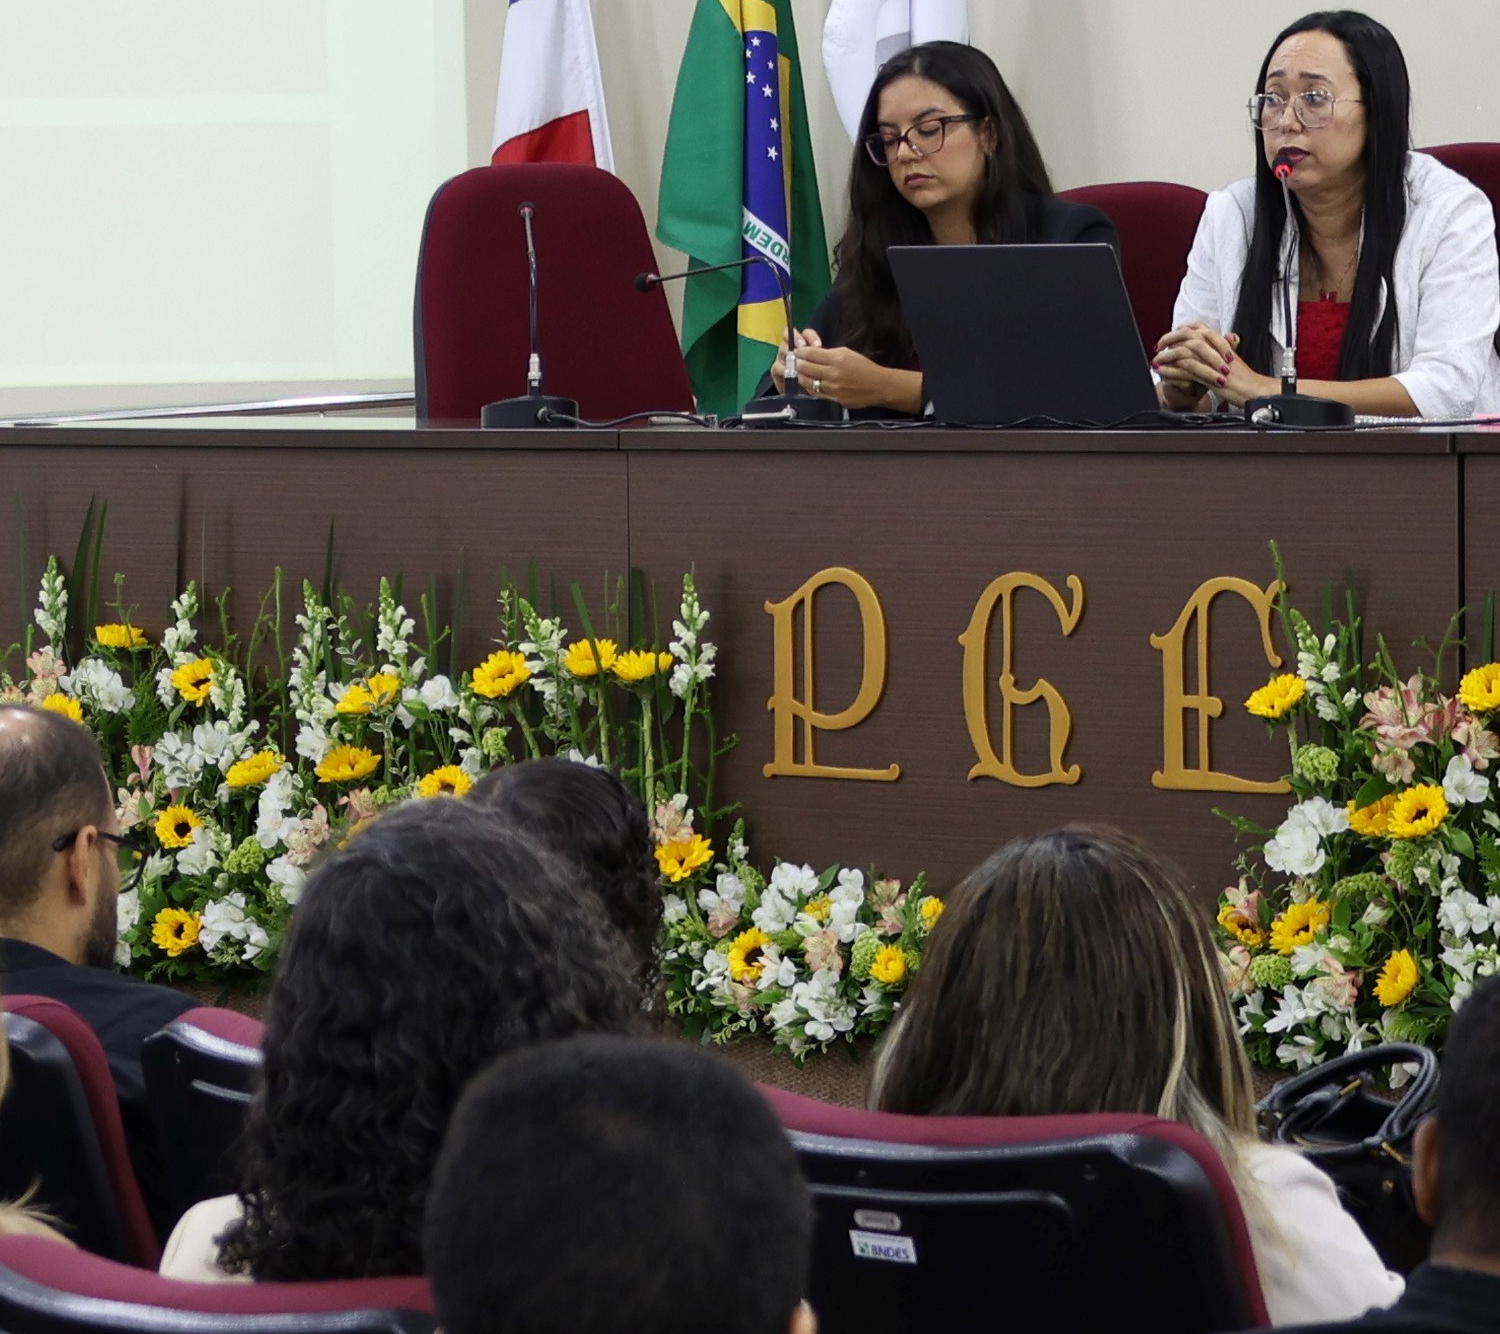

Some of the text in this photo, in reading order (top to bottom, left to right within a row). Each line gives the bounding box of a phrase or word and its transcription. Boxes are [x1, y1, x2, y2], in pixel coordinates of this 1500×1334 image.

[744, 221, 789, 265] RDEM
[762, 567, 1292, 794] PGE
[871, 1245, 909, 1259] BNDES
